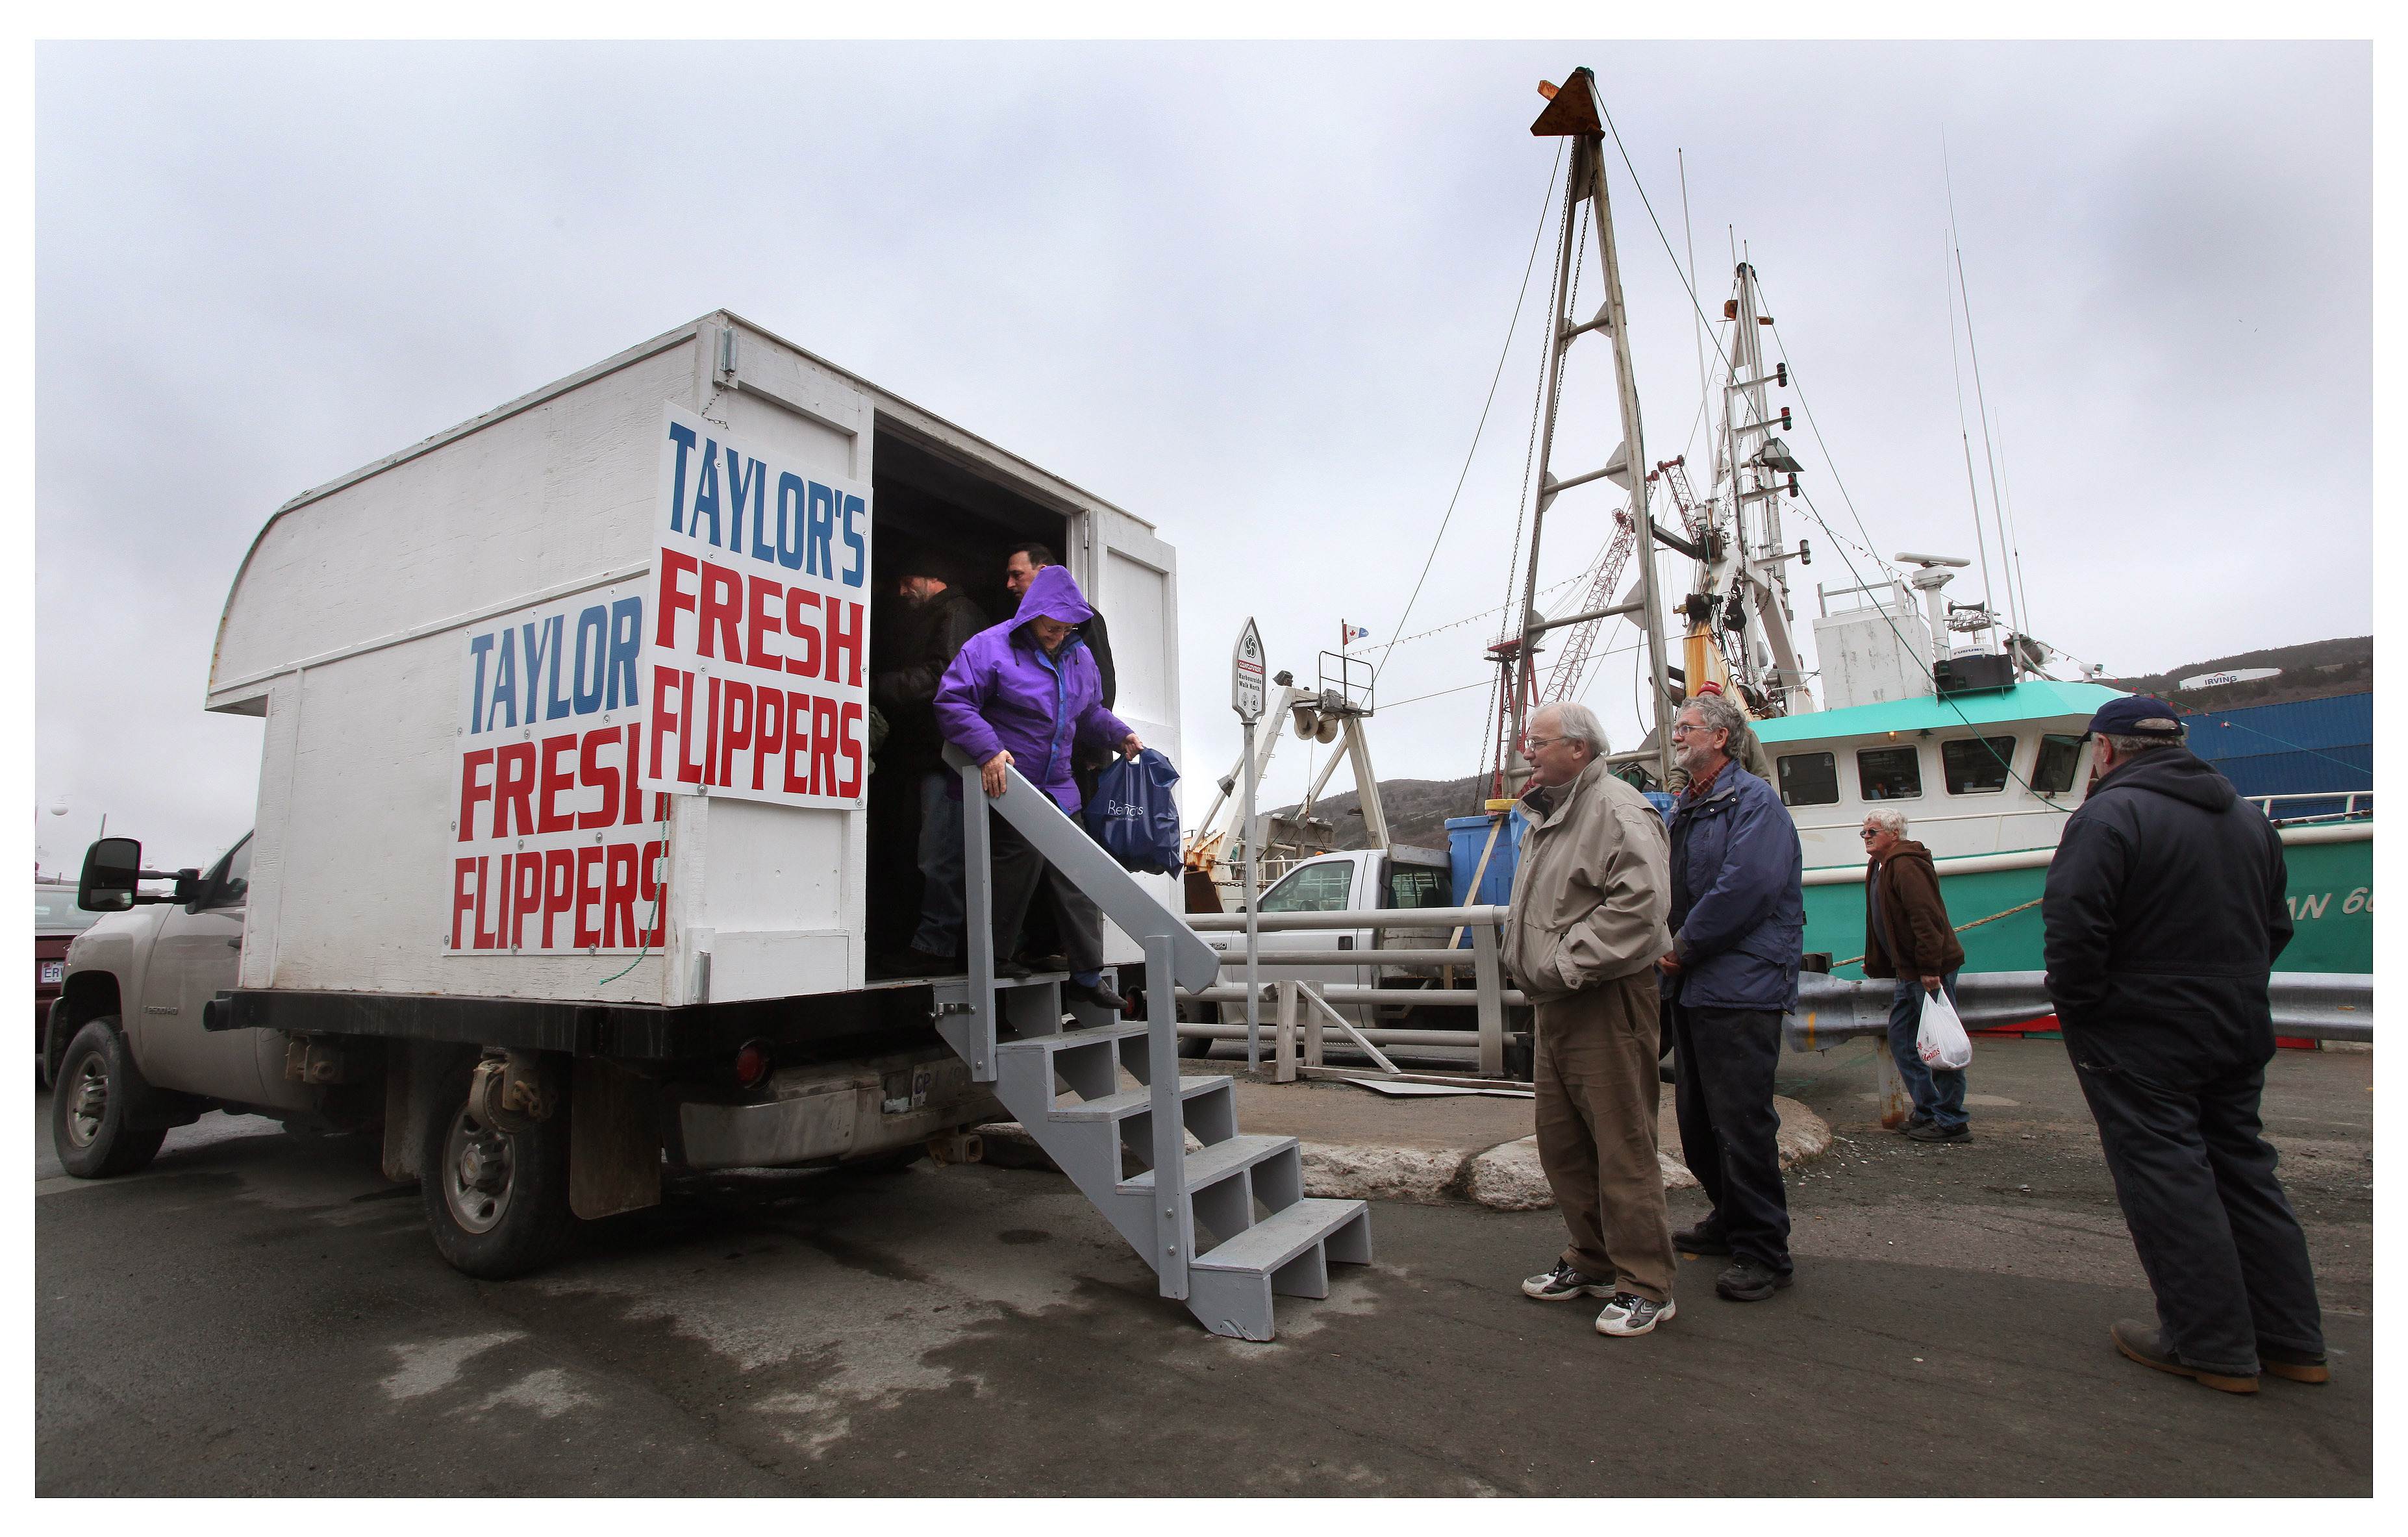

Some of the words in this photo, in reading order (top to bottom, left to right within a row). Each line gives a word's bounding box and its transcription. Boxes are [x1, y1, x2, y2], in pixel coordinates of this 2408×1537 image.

[669, 421, 865, 588] TAYLOR'S
[655, 547, 865, 688] FRESH
[1238, 673, 1261, 684] Harbourside
[649, 664, 864, 799] FLIPPERS
[2205, 675, 2237, 685] IRVING
[451, 840, 670, 950] FLIPPERS
